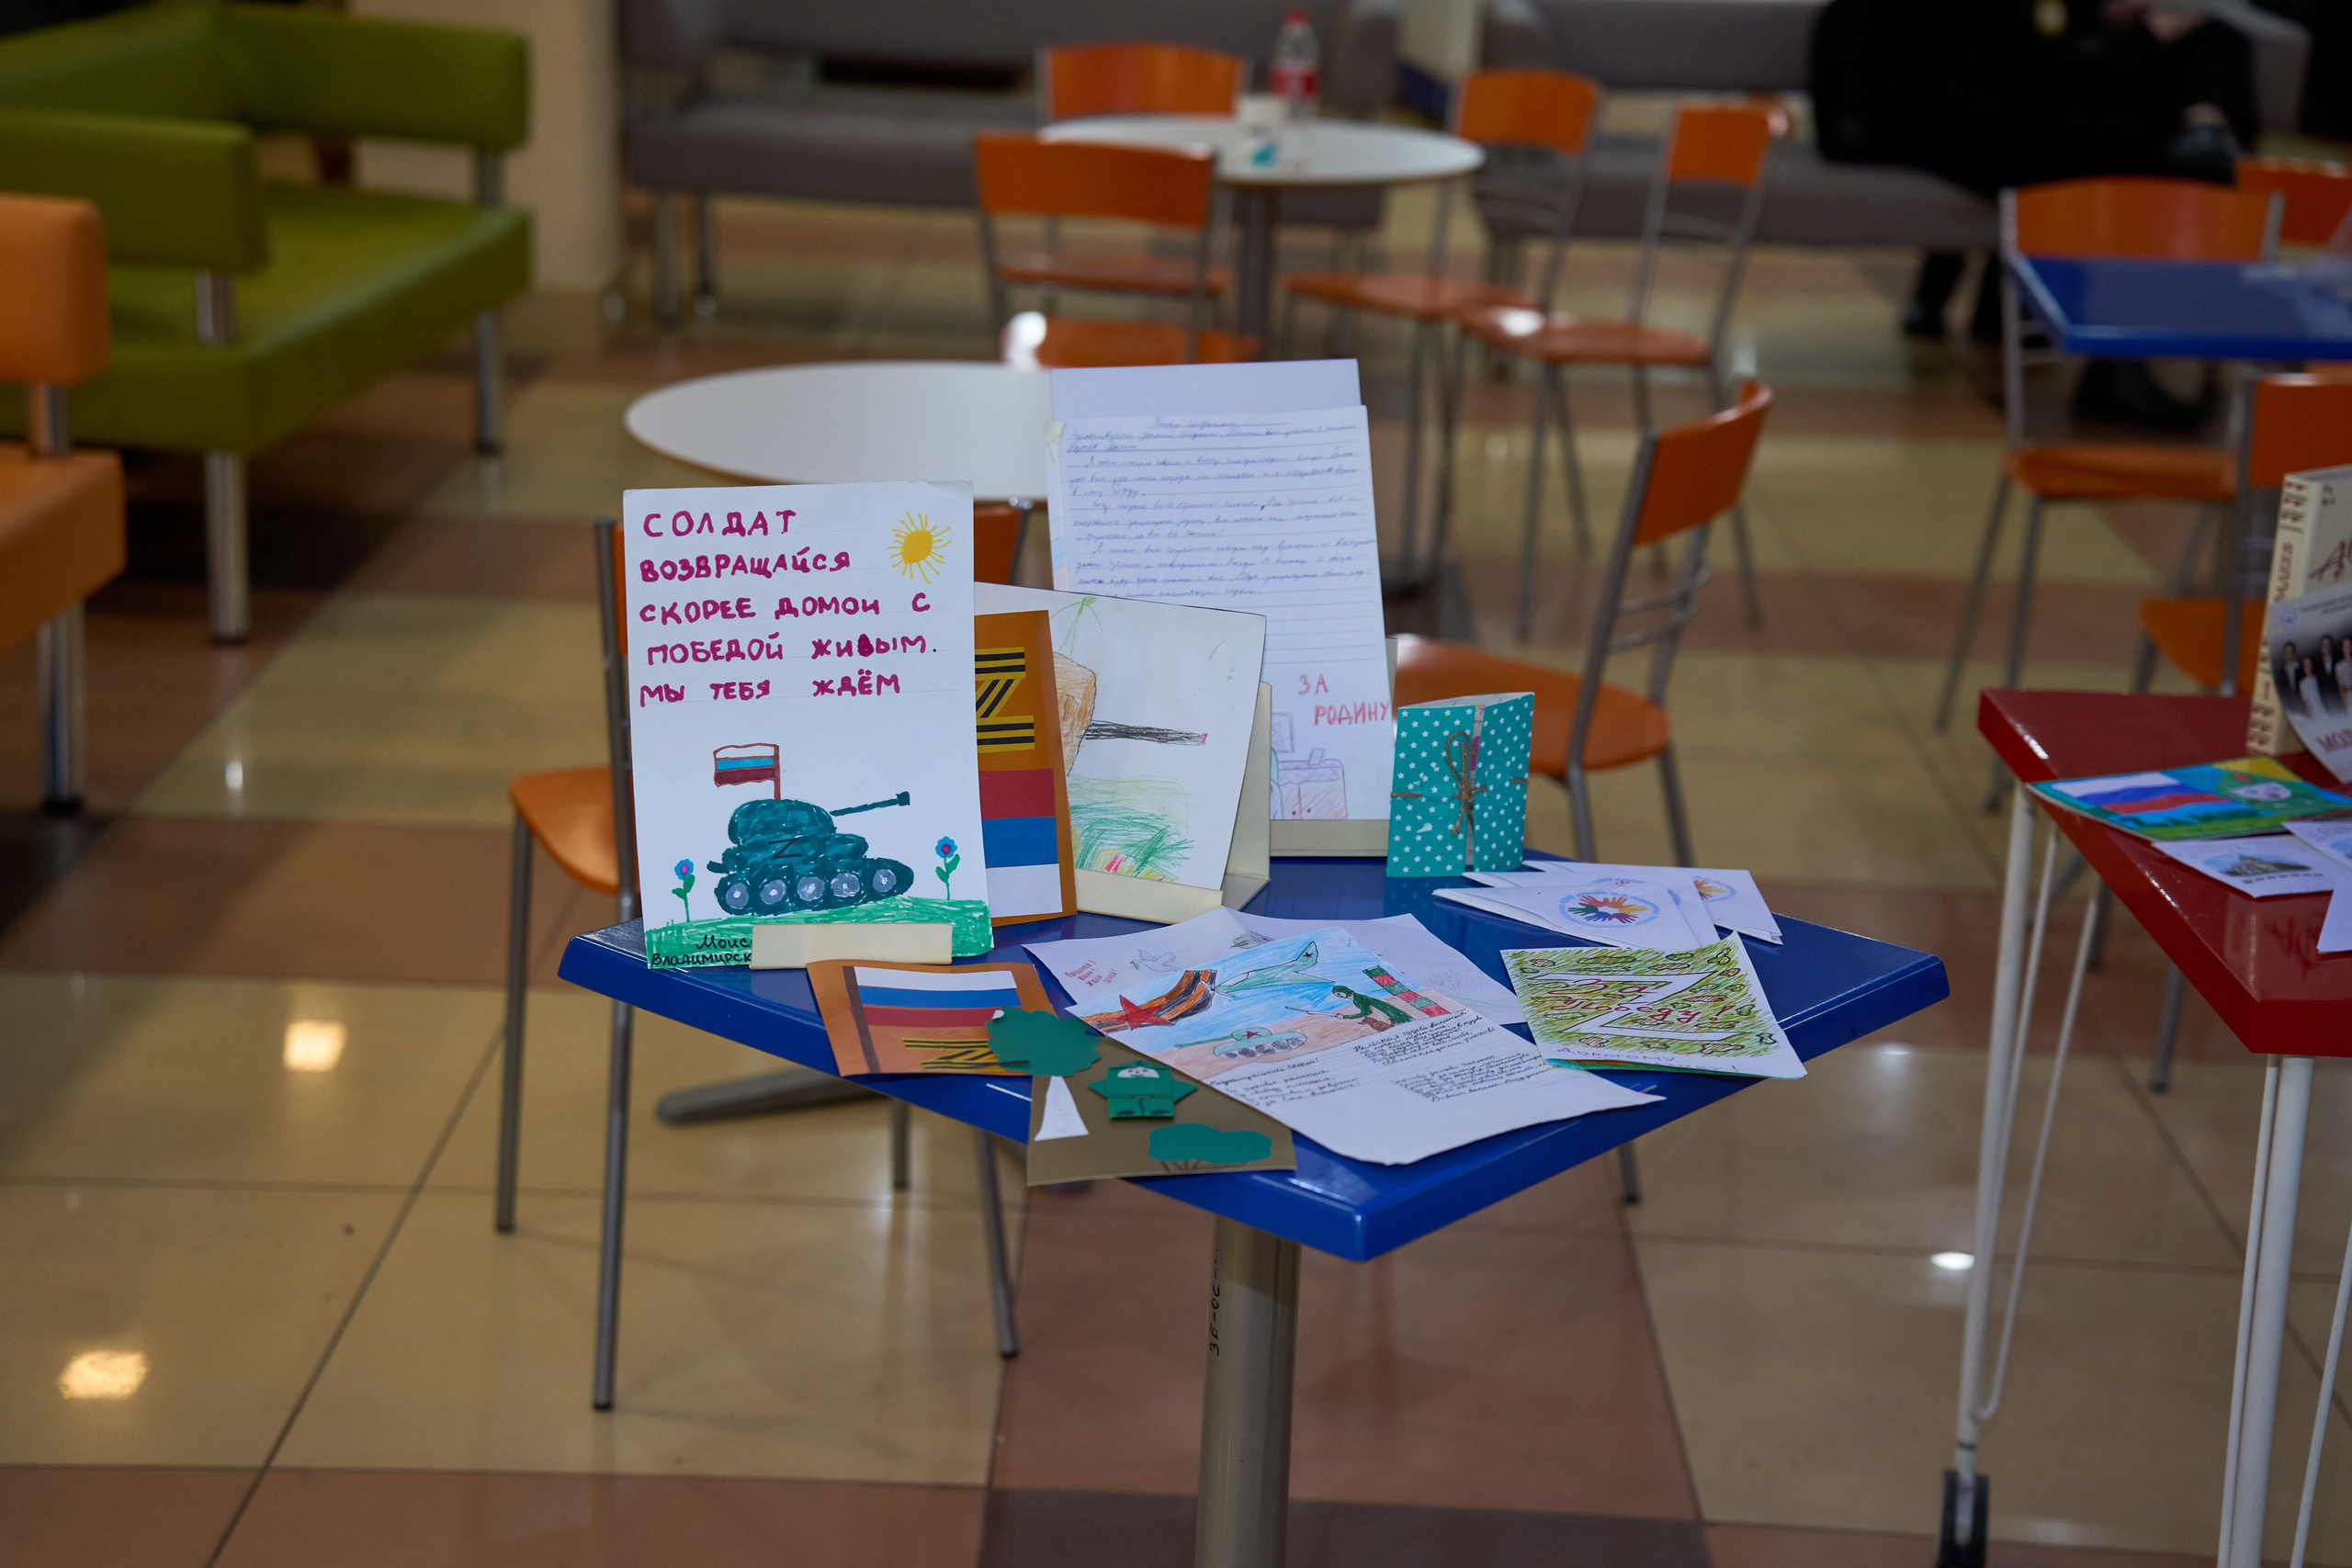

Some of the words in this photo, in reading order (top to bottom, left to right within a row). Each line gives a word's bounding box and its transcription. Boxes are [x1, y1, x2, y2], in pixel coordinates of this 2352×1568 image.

[643, 510, 797, 536] СОЛДАТ
[639, 547, 850, 582] ВОЗВРАЩАЙСЯ
[639, 597, 756, 625] СКОРЕЕ
[911, 592, 931, 613] С
[647, 632, 784, 665] ПОБЕДОЙ
[639, 683, 685, 707] МЫ
[709, 679, 770, 701] ТЕБЯ
[813, 669, 900, 696] ЖДЁМ
[1298, 673, 1329, 695] ЗА
[1315, 702, 1389, 726] РОДИНУ
[695, 934, 752, 950] Моис
[651, 953, 752, 966] Владимирск
